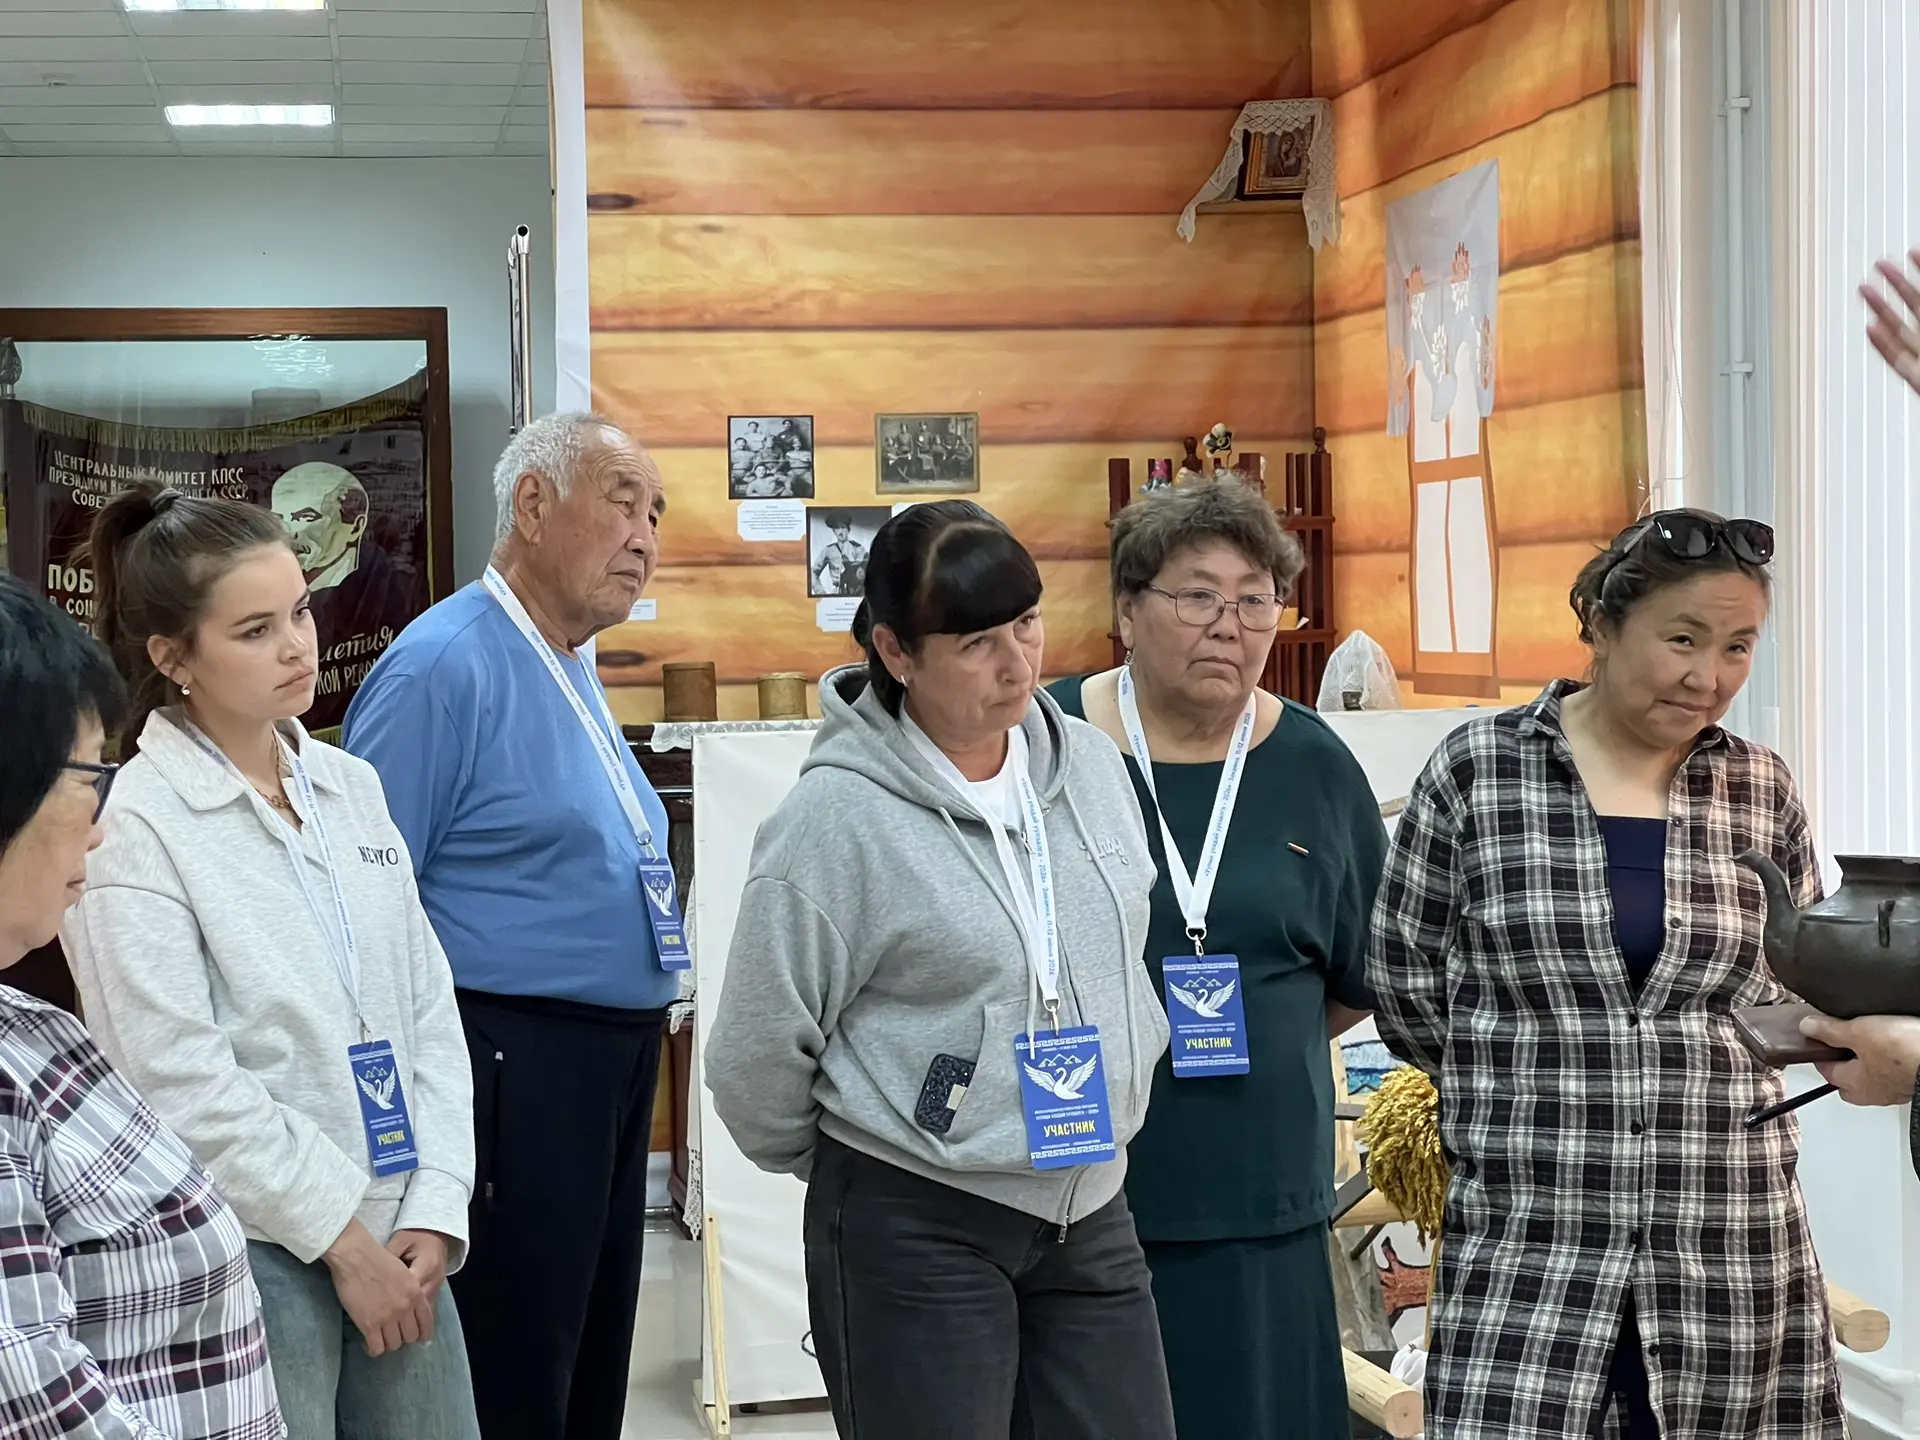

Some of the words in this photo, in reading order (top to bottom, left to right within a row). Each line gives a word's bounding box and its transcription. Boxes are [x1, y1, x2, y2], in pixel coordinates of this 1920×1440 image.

[49, 466, 107, 493] ПРЕЗИДИУМ
[149, 466, 206, 485] КОМИТЕТ
[211, 467, 244, 485] КПСС
[48, 564, 94, 594] ПОБ
[66, 598, 93, 618] СОЦ
[317, 666, 341, 695] КОЙ
[1185, 1037, 1233, 1050] УЧАСТНИК
[1043, 1120, 1096, 1138] УЧАСТНИК
